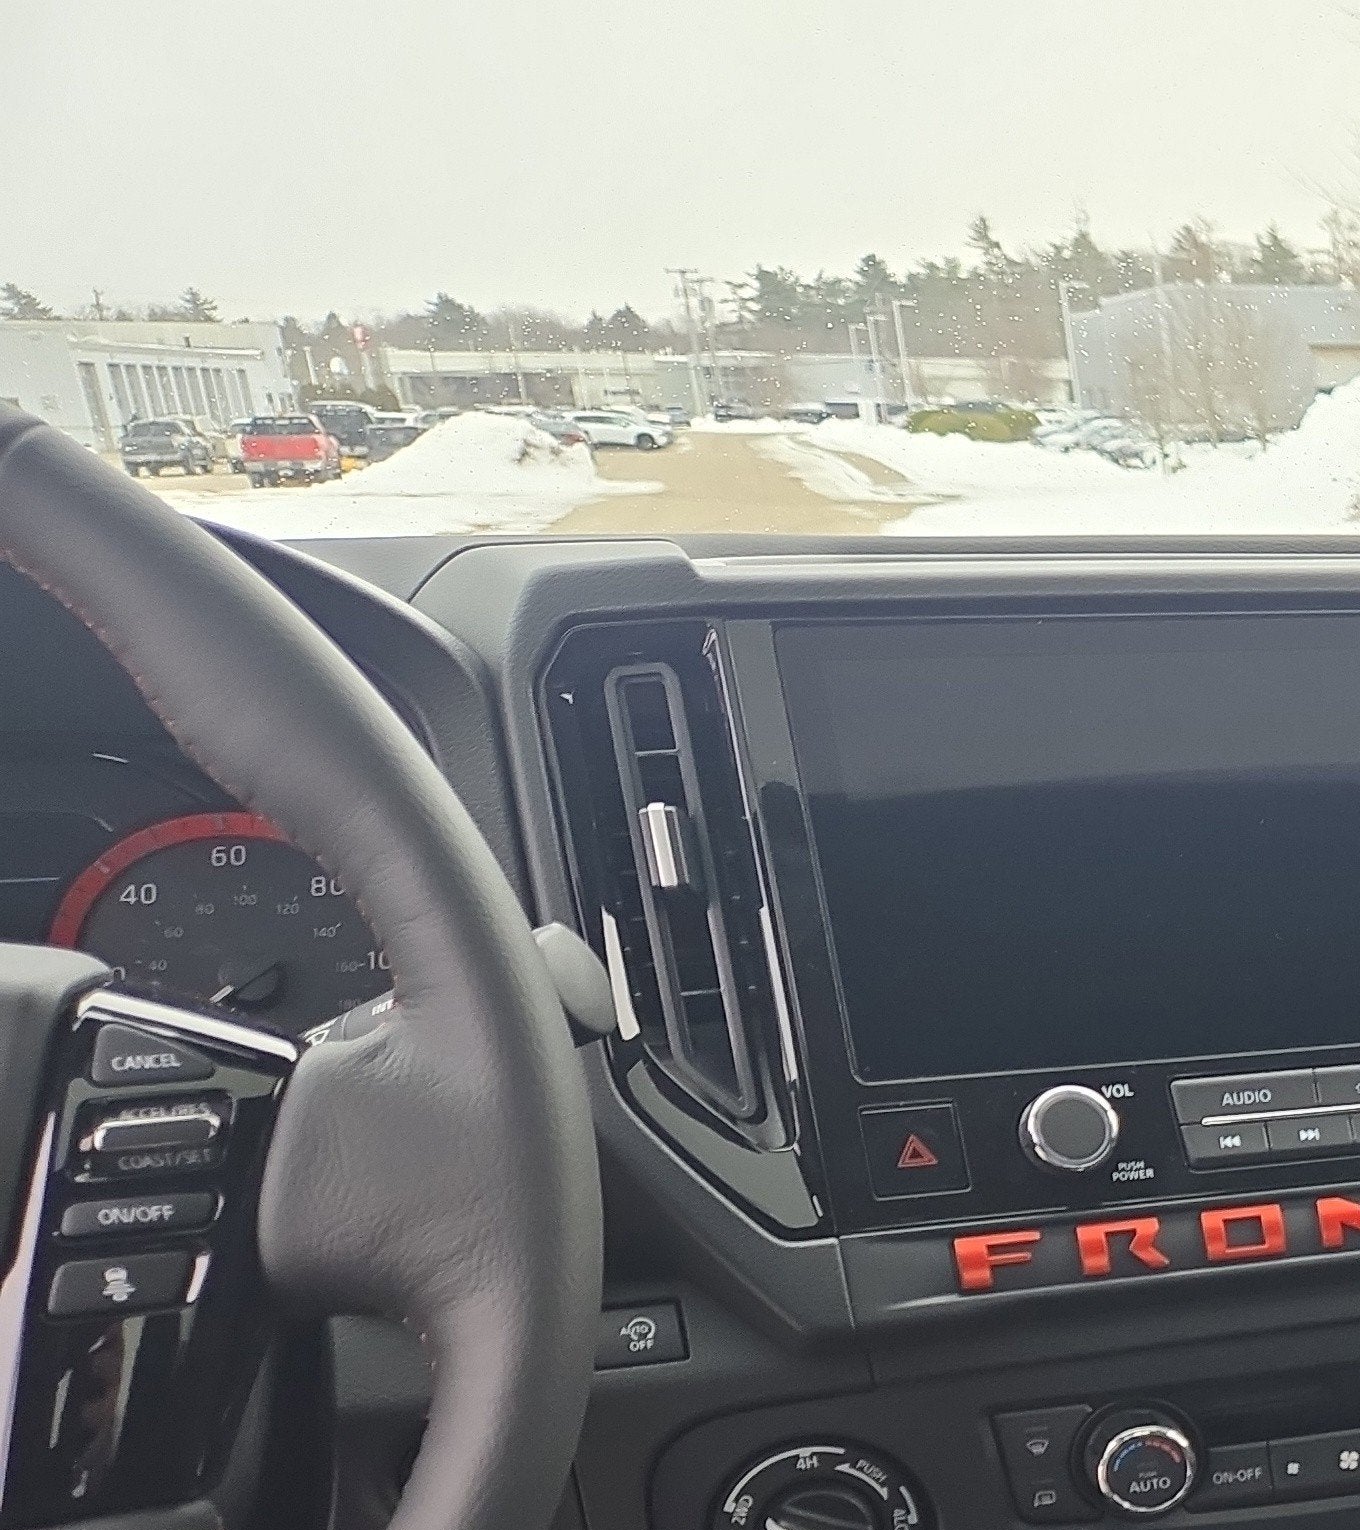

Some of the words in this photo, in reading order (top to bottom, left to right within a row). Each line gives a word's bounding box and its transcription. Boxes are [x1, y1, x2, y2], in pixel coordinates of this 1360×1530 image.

[211, 845, 246, 867] 60
[119, 883, 157, 906] 40
[366, 950, 392, 970] 10
[111, 1053, 182, 1072] CANCEL
[1101, 1083, 1134, 1099] VOL
[1222, 1089, 1272, 1106] AUDIO
[1112, 1168, 1154, 1182] POWER
[98, 1204, 175, 1225] ON/OFF
[796, 1455, 818, 1470] 4H
[855, 1459, 888, 1484] PUSH
[1129, 1477, 1171, 1494] AUTO
